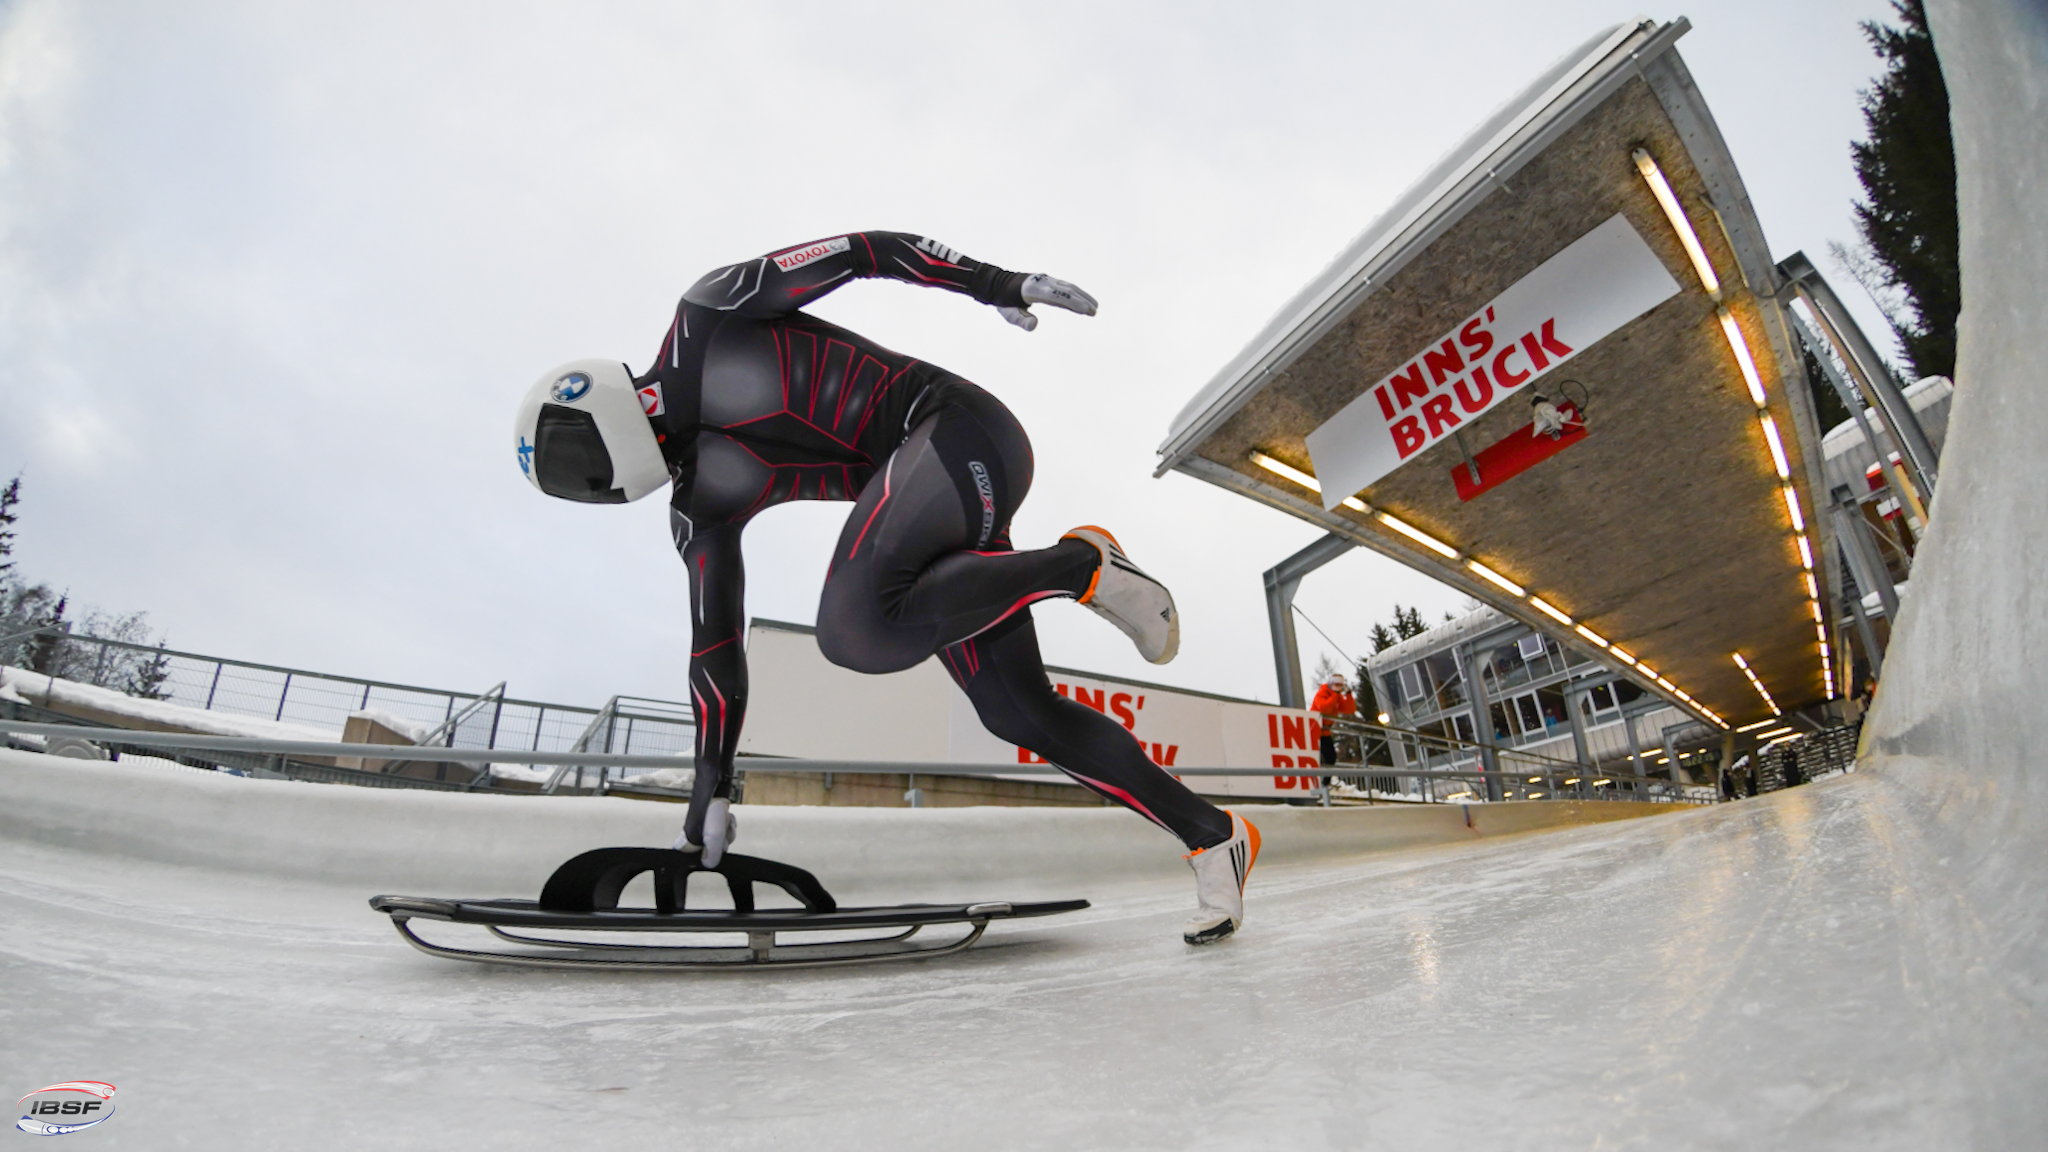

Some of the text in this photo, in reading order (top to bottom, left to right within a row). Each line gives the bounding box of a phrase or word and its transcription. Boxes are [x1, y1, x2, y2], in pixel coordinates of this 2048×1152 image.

[777, 245, 831, 268] TOYOTA
[1374, 305, 1495, 421] INNS'
[1389, 317, 1574, 460] BRUCK
